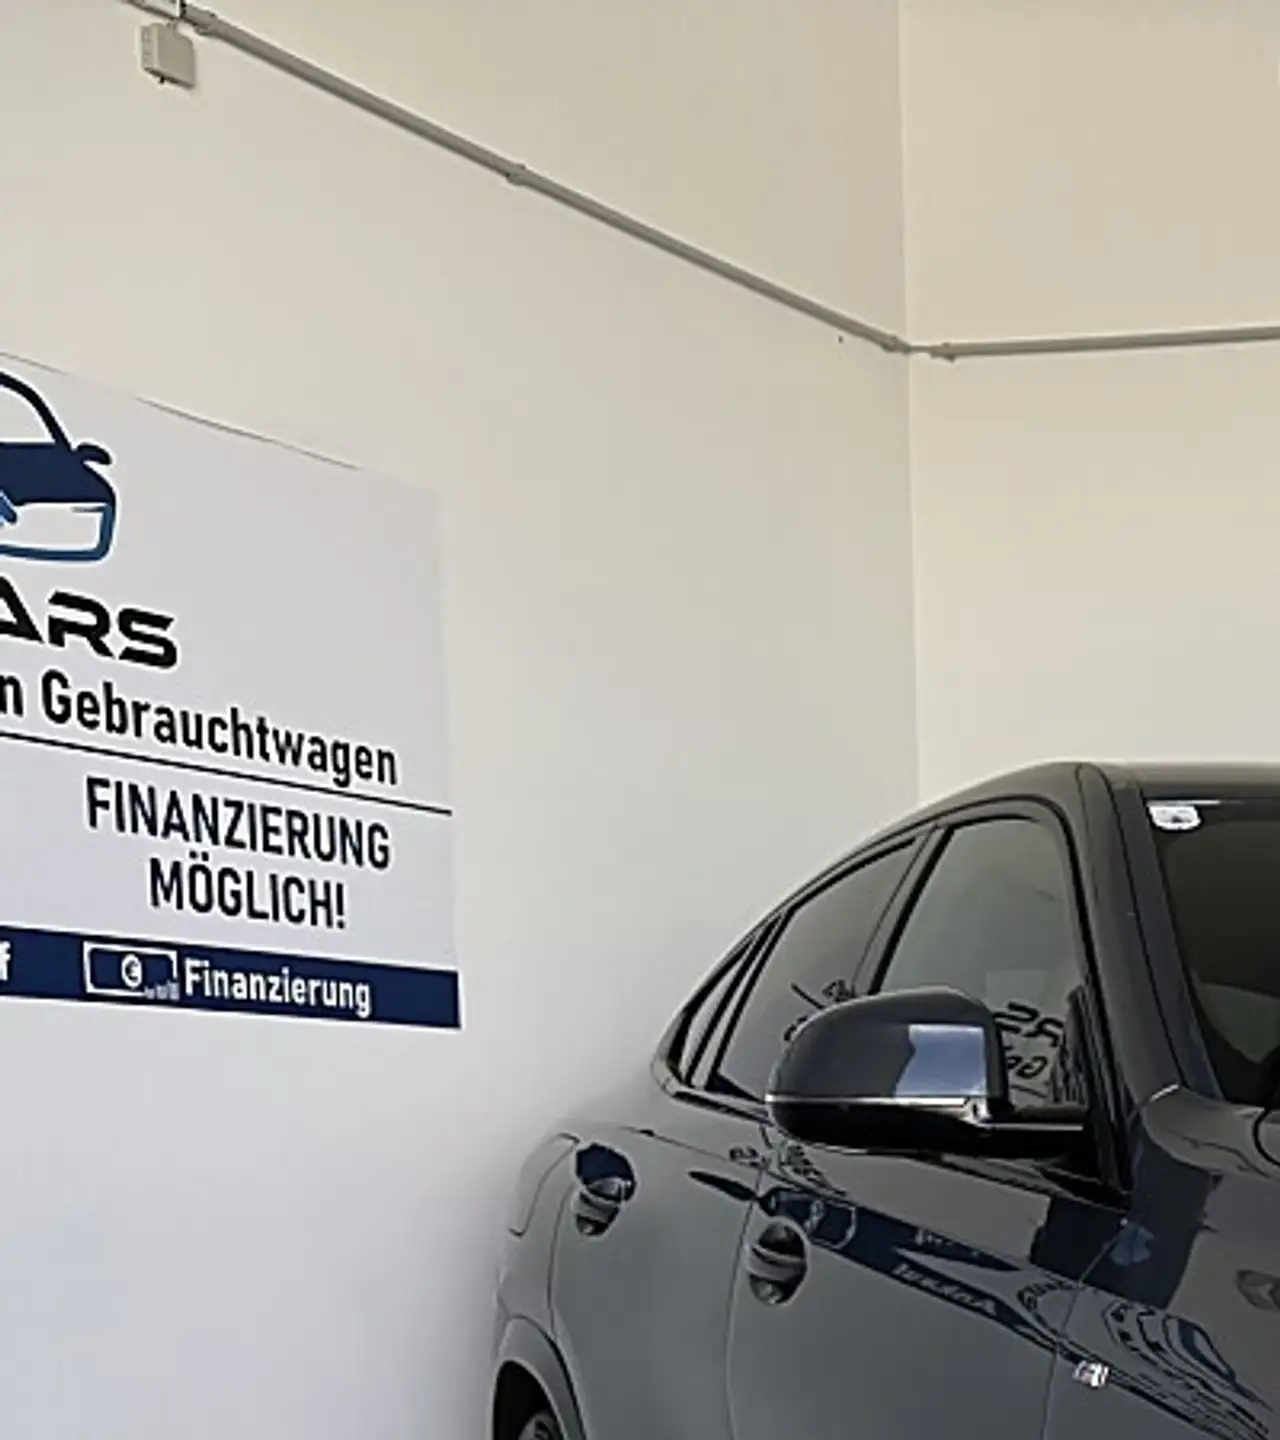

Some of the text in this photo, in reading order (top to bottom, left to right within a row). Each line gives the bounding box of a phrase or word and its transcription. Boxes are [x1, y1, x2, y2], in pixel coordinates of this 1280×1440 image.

[41, 668, 398, 786] Gebrauchtwagen
[86, 775, 391, 869] FINANZIERUNG
[149, 851, 345, 930] MÖGLICH!
[185, 960, 372, 1017] Finanzierung
